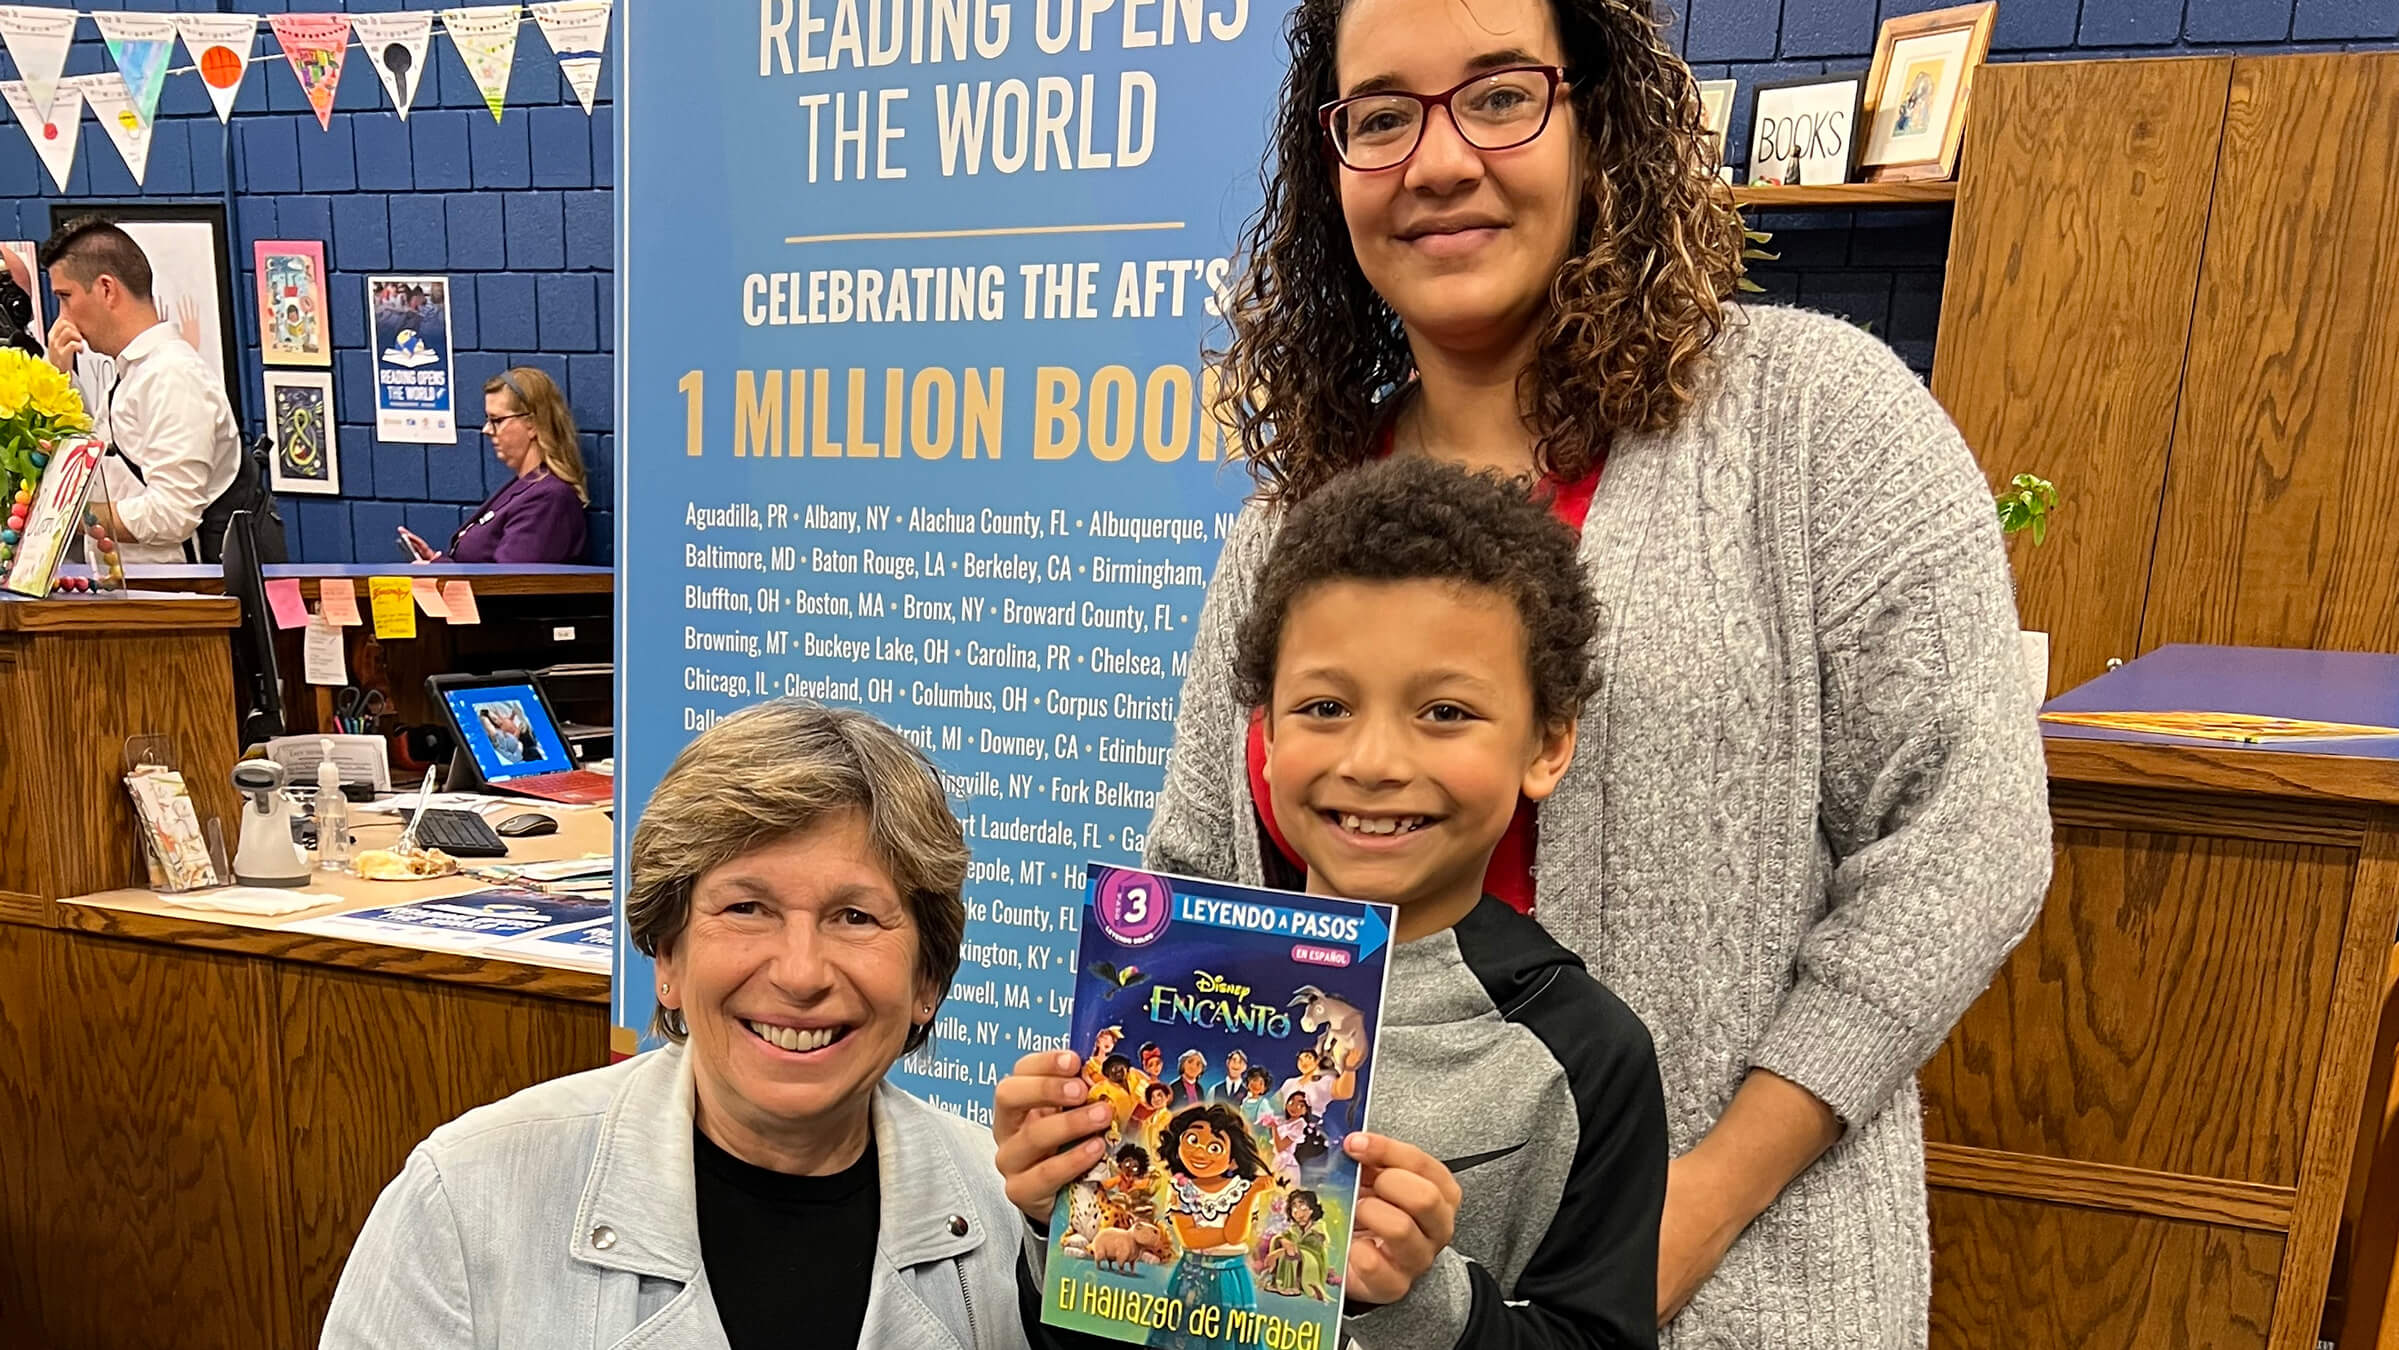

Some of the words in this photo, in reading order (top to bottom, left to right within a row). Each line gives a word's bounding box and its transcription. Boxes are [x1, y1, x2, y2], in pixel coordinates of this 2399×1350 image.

[759, 0, 1011, 77] READING
[1035, 0, 1249, 55] OPENS
[798, 87, 909, 184] THE
[935, 70, 1157, 177] WORLD
[1757, 111, 1845, 163] BOOKS
[743, 264, 1005, 327] CELEBRATING
[1019, 262, 1100, 320] THE
[1111, 257, 1232, 318] AFT'S
[679, 369, 704, 457] 1
[733, 366, 1005, 461] MILLION
[1033, 364, 1246, 463] BOOK
[685, 501, 763, 531] Aguadilla,
[767, 503, 788, 529] PR
[804, 504, 861, 534] Albany,
[866, 505, 891, 531] NY
[908, 506, 976, 534] Alachua
[980, 507, 1044, 539] County,
[1050, 509, 1070, 536] FL
[1089, 510, 1208, 545] Albuquerque,
[685, 543, 767, 573] Baltimore,
[771, 546, 796, 571] MD
[812, 547, 858, 574] Baton
[863, 548, 919, 581] Rouge,
[924, 551, 945, 577] LA
[964, 552, 1042, 584] Berkeley,
[1047, 554, 1072, 582] CA
[1092, 556, 1207, 590] Birmingham,
[685, 584, 753, 615] Bluffton,
[757, 587, 780, 613] OH
[796, 589, 853, 619] Boston,
[858, 591, 885, 618] MA
[903, 593, 956, 625] Bronx,
[961, 596, 985, 623] NY
[1003, 598, 1075, 627] Broward
[1081, 601, 1149, 634] County,
[1154, 604, 1174, 631] FL
[684, 626, 762, 658] Browning,
[766, 630, 789, 655] MT
[804, 631, 870, 663] Buckeye
[875, 635, 919, 665] Lake,
[923, 638, 949, 665] OH
[967, 640, 1041, 673] Carolina,
[1046, 644, 1071, 671] PR
[1090, 646, 1165, 680] Chelsea,
[1171, 650, 1188, 678] M
[684, 666, 751, 698] Chicago,
[755, 671, 769, 695] IL
[784, 673, 863, 703] Cleveland,
[868, 678, 893, 704] OH
[912, 680, 997, 714] Columbus,
[1002, 686, 1028, 713] OH
[1046, 688, 1108, 722] Corpus
[684, 707, 722, 732] Dall
[897, 722, 937, 753] troit,
[941, 725, 962, 751] MI
[980, 728, 1049, 761] Downey,
[1054, 733, 1079, 760] CA
[941, 769, 1004, 801] ingville,
[1009, 773, 1033, 799] NY
[1051, 776, 1090, 804] Fork
[981, 813, 1077, 850] Lauderdale,
[1083, 822, 1102, 849] FL
[1121, 826, 1145, 853] Ga
[967, 857, 1014, 887] epole,
[1020, 859, 1046, 886] MT
[1063, 864, 1087, 891] Ho
[991, 899, 1054, 932] County,
[1059, 906, 1079, 932] FL
[1123, 887, 1148, 924] 3
[1181, 896, 1276, 931] LEYENDO
[1278, 917, 1288, 929] A
[959, 939, 1022, 970] xington,
[1027, 944, 1051, 970] KY
[1295, 948, 1309, 960] EN
[1309, 950, 1347, 965] ESPAÑOL
[1004, 983, 1030, 1010] MA
[1149, 984, 1293, 1040] ENCANTO
[934, 1016, 972, 1046] ville,
[976, 1020, 1000, 1046] NY
[903, 1056, 973, 1086] Metairie,
[978, 1060, 998, 1087] LA
[966, 1098, 994, 1126] Hav
[1058, 1276, 1079, 1311] El
[1082, 1281, 1183, 1331] Hallazgo
[1188, 1300, 1222, 1340] de
[1225, 1308, 1322, 1350] Mirabel
